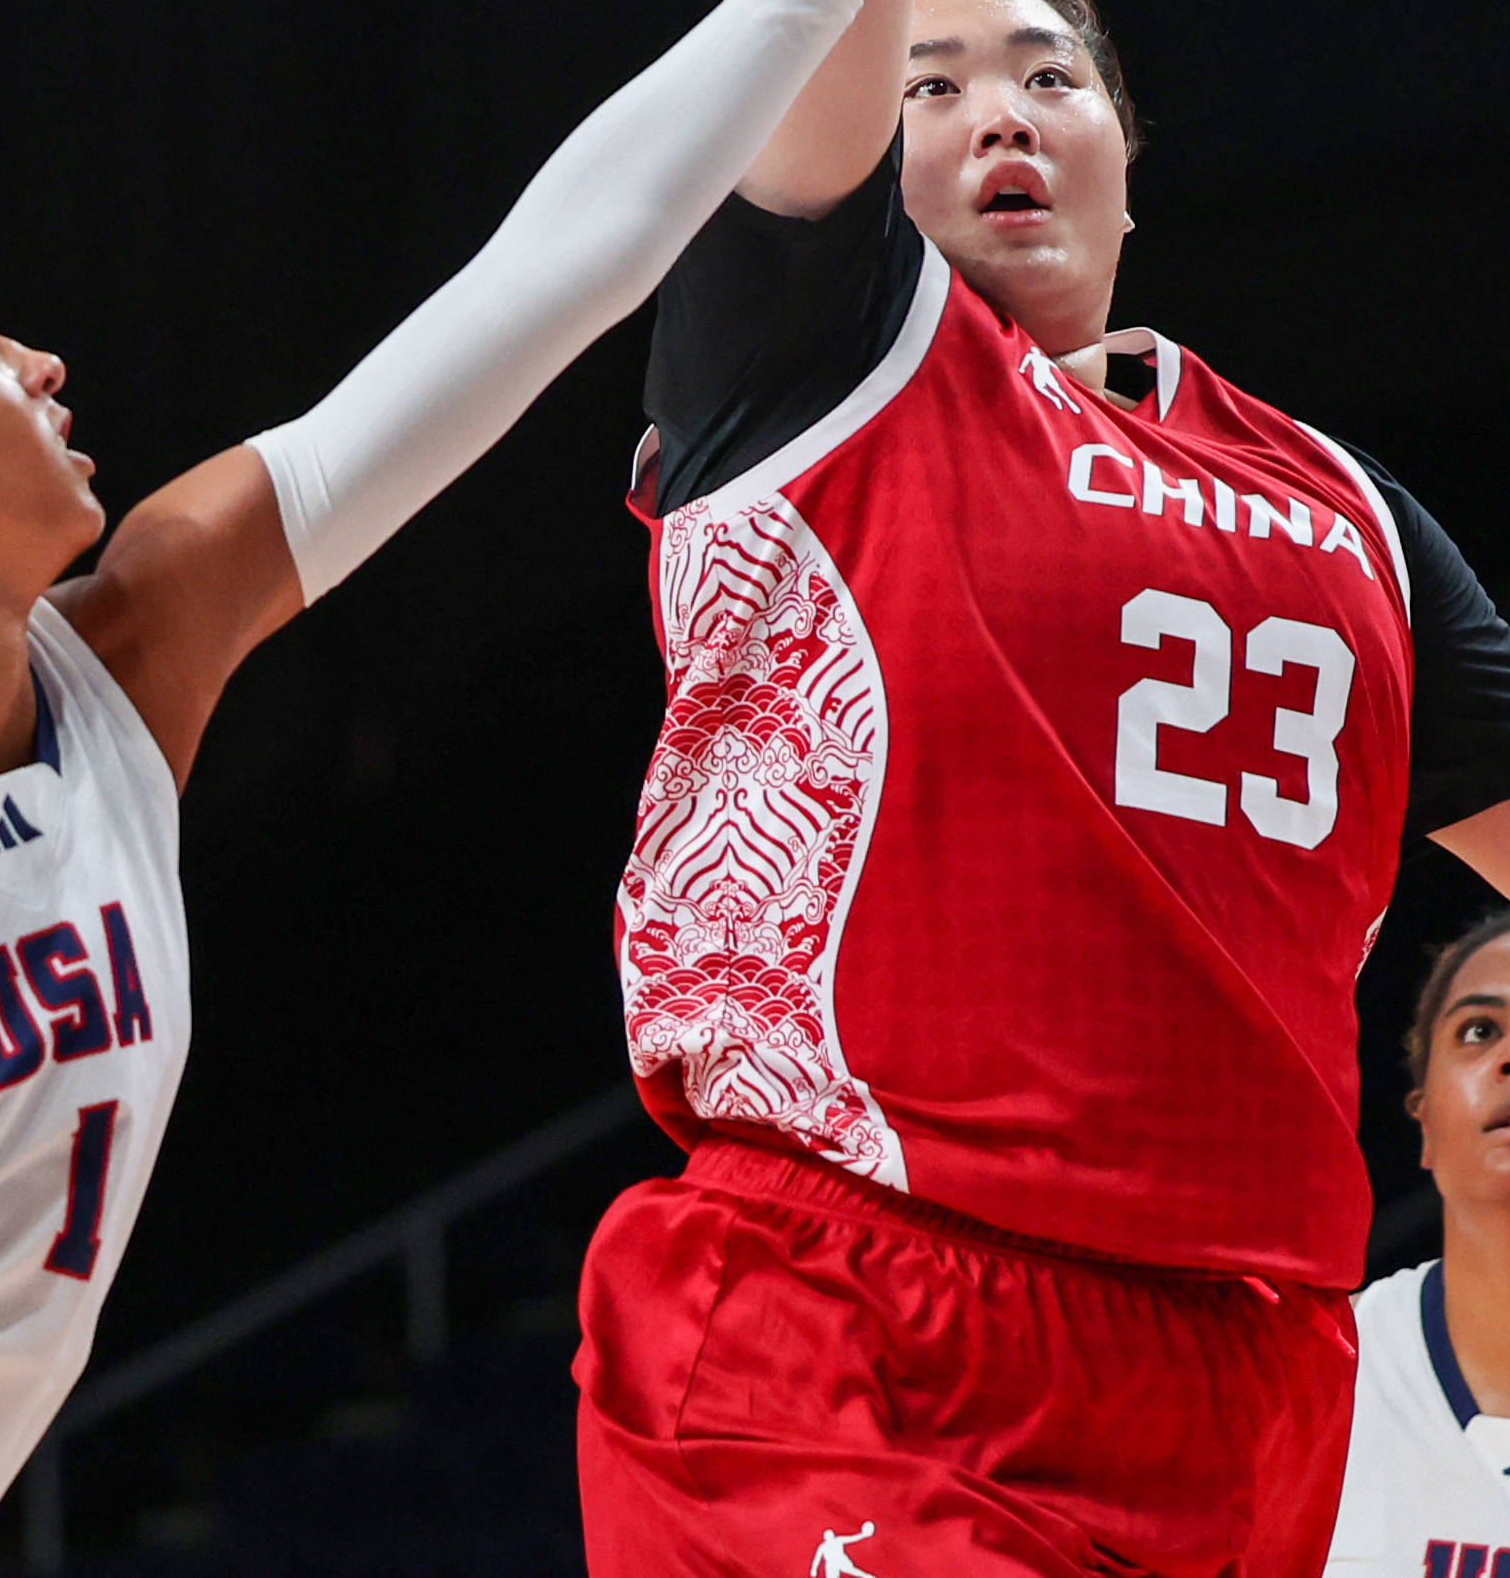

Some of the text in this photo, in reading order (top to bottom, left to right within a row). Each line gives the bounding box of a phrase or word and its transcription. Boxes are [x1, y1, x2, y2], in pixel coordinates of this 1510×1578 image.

[1068, 443, 1374, 581] CHINA
[1115, 588, 1356, 850] 23
[43, 1100, 119, 1281] 1
